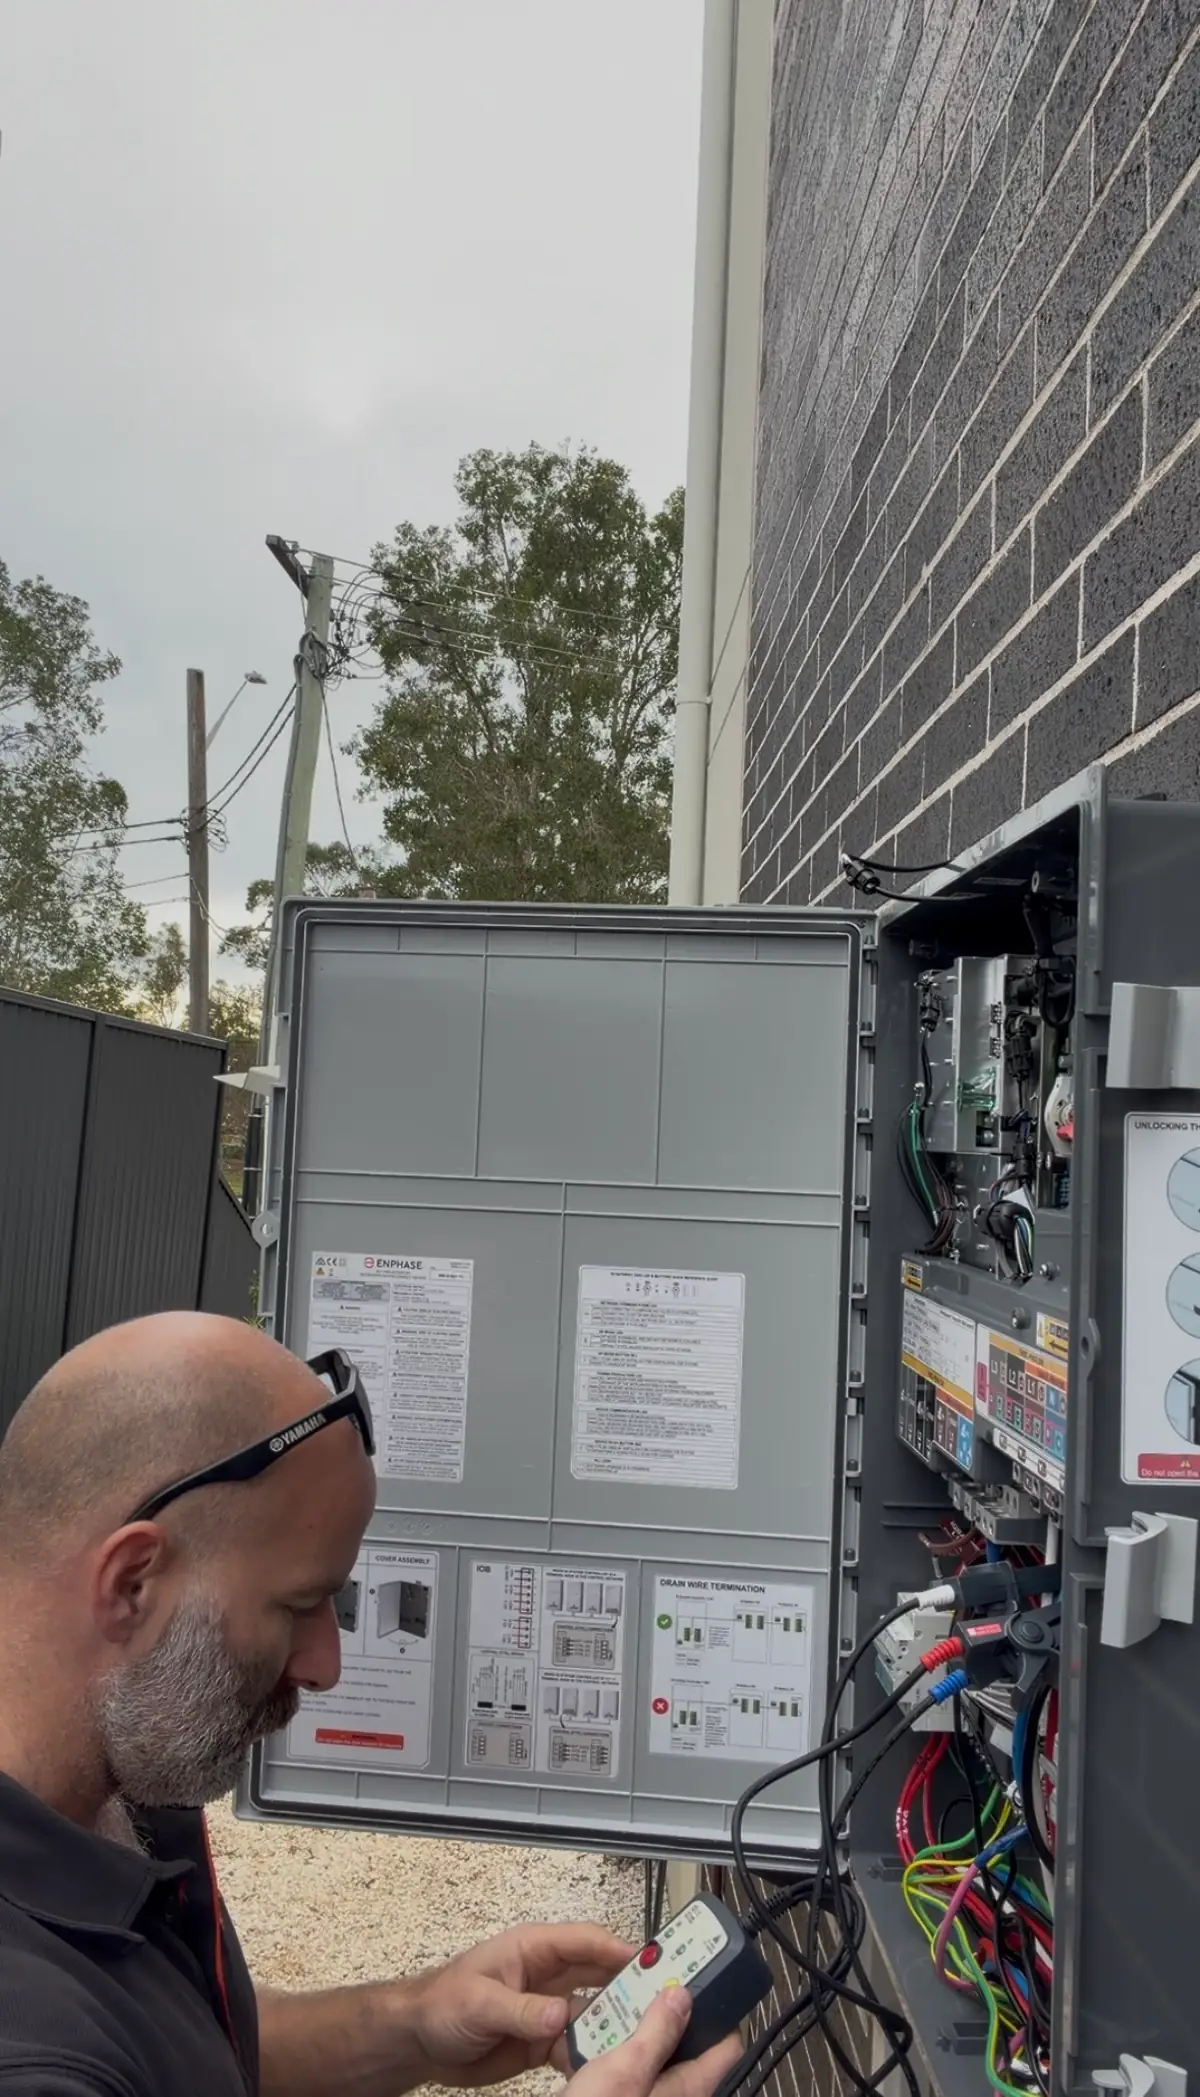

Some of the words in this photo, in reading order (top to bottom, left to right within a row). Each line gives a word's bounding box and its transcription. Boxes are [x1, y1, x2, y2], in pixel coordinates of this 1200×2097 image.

[1134, 1121, 1188, 1130] UNLOCKING
[376, 1258, 423, 1270] ENPHASE
[281, 1412, 327, 1445] YAMAHA
[660, 1579, 686, 1588] DRAIN
[688, 1580, 708, 1590] WIRE
[710, 1582, 766, 1594] TERMINATION
